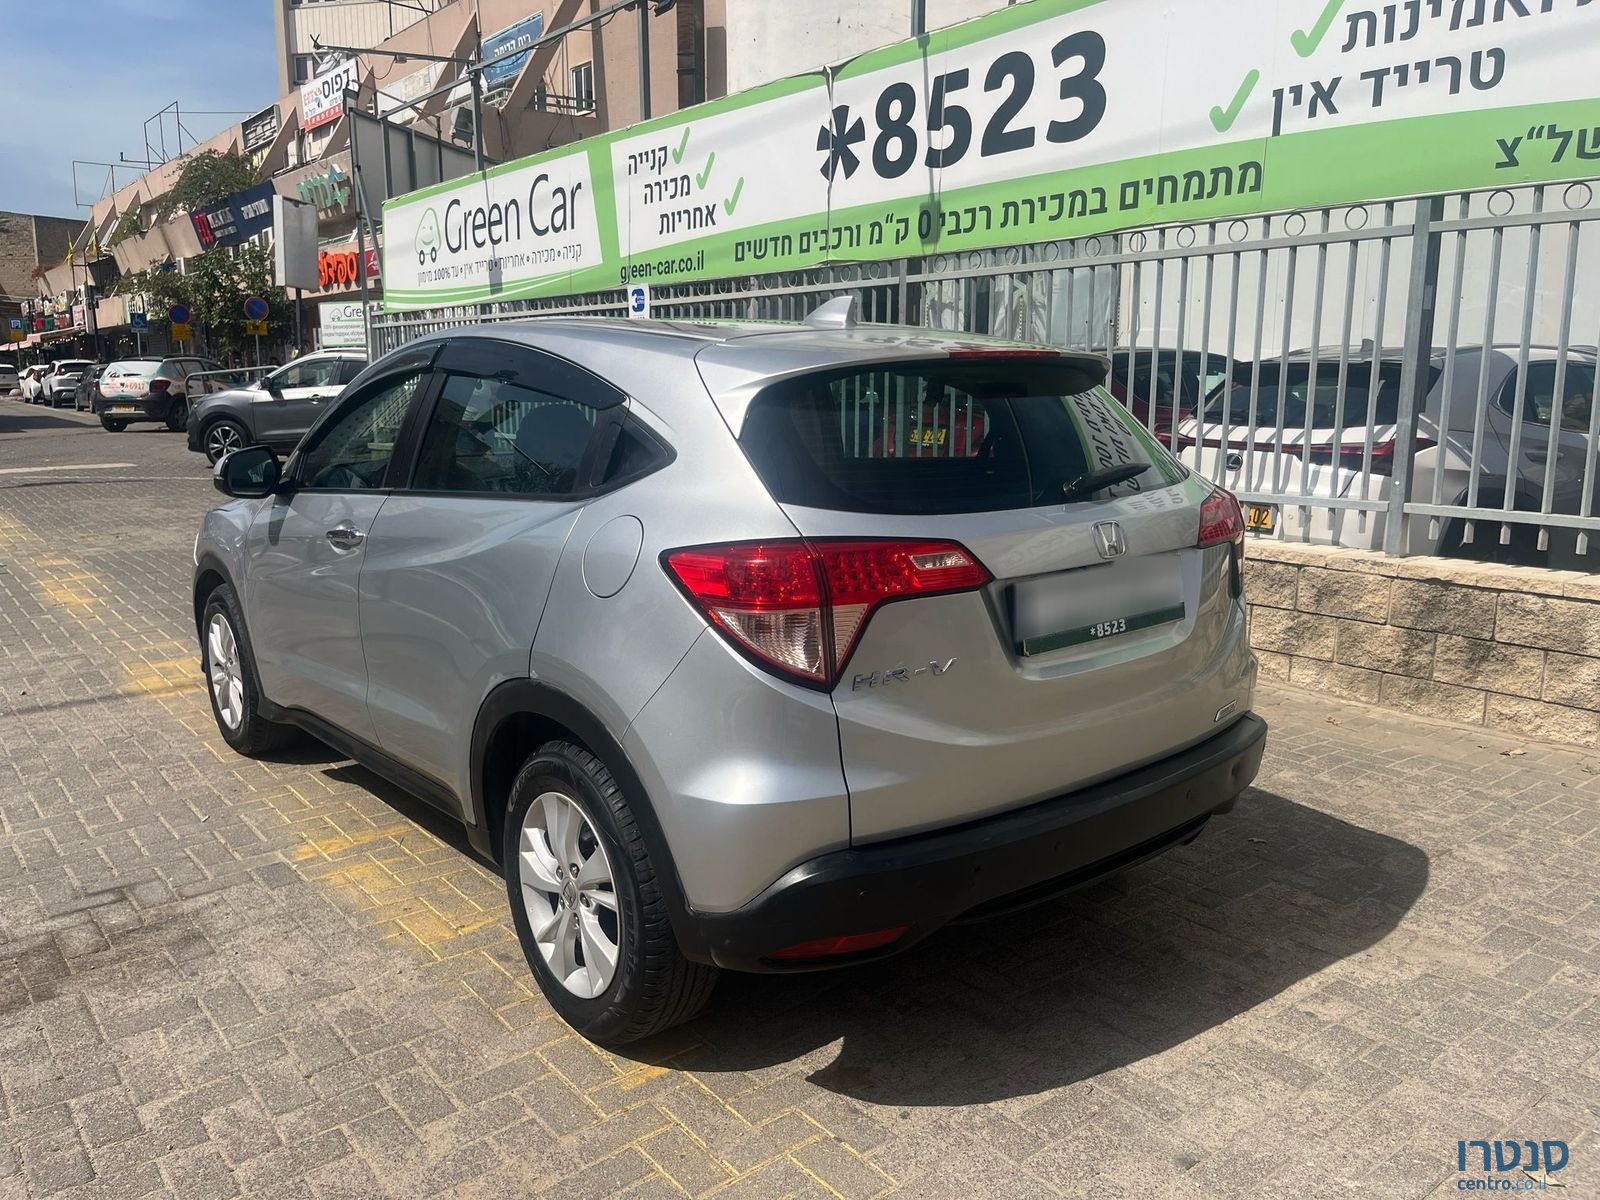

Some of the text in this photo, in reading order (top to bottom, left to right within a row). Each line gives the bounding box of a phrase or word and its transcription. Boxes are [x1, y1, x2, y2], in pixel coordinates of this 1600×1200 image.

[1272, 47, 1506, 137] טרייד אין
[628, 145, 668, 176] קנייה
[644, 173, 691, 205] מכירה
[1119, 160, 1262, 211] מתמחים
[445, 174, 582, 254] Green Car
[659, 203, 717, 236] אחריות
[939, 202, 992, 236] רכבי
[1000, 186, 1107, 229] במכירת
[799, 224, 861, 255] ורכבים
[918, 209, 932, 240] 0
[531, 248, 556, 265] מכירה
[563, 244, 582, 263] קניה
[734, 234, 793, 263] חדשים
[620, 251, 705, 283] green-car.co.il
[852, 657, 957, 691] HR-V
